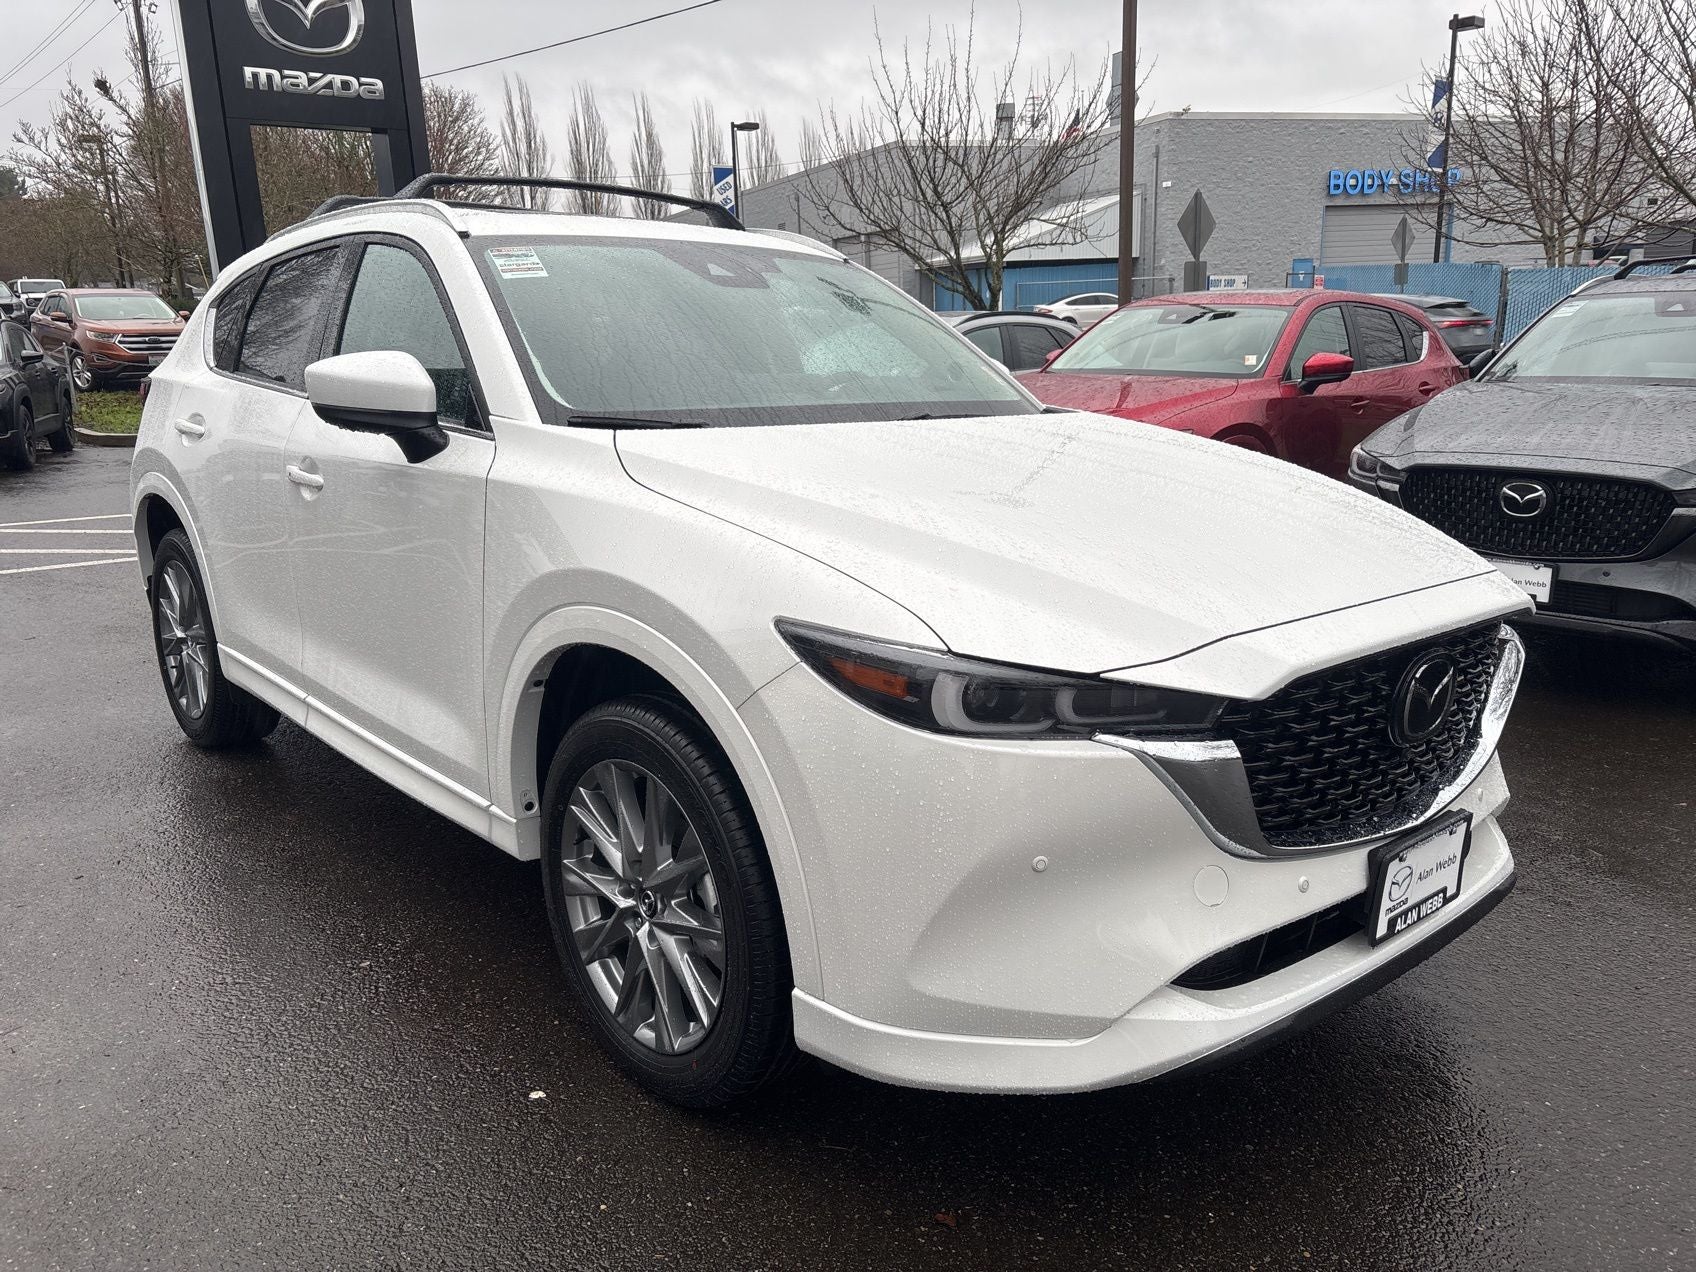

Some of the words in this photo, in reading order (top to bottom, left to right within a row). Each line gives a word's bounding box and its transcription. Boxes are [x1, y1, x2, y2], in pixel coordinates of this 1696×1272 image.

[716, 181, 732, 195] USED
[1328, 168, 1394, 196] BODY
[720, 195, 732, 206] ARS
[1210, 278, 1222, 288] BODY
[1223, 278, 1236, 288] SHOP
[1524, 579, 1547, 588] Webb
[1416, 867, 1433, 884] Alan
[1435, 852, 1457, 873] Webb
[1394, 907, 1418, 933] ALAN
[1420, 893, 1443, 917] WEBB
